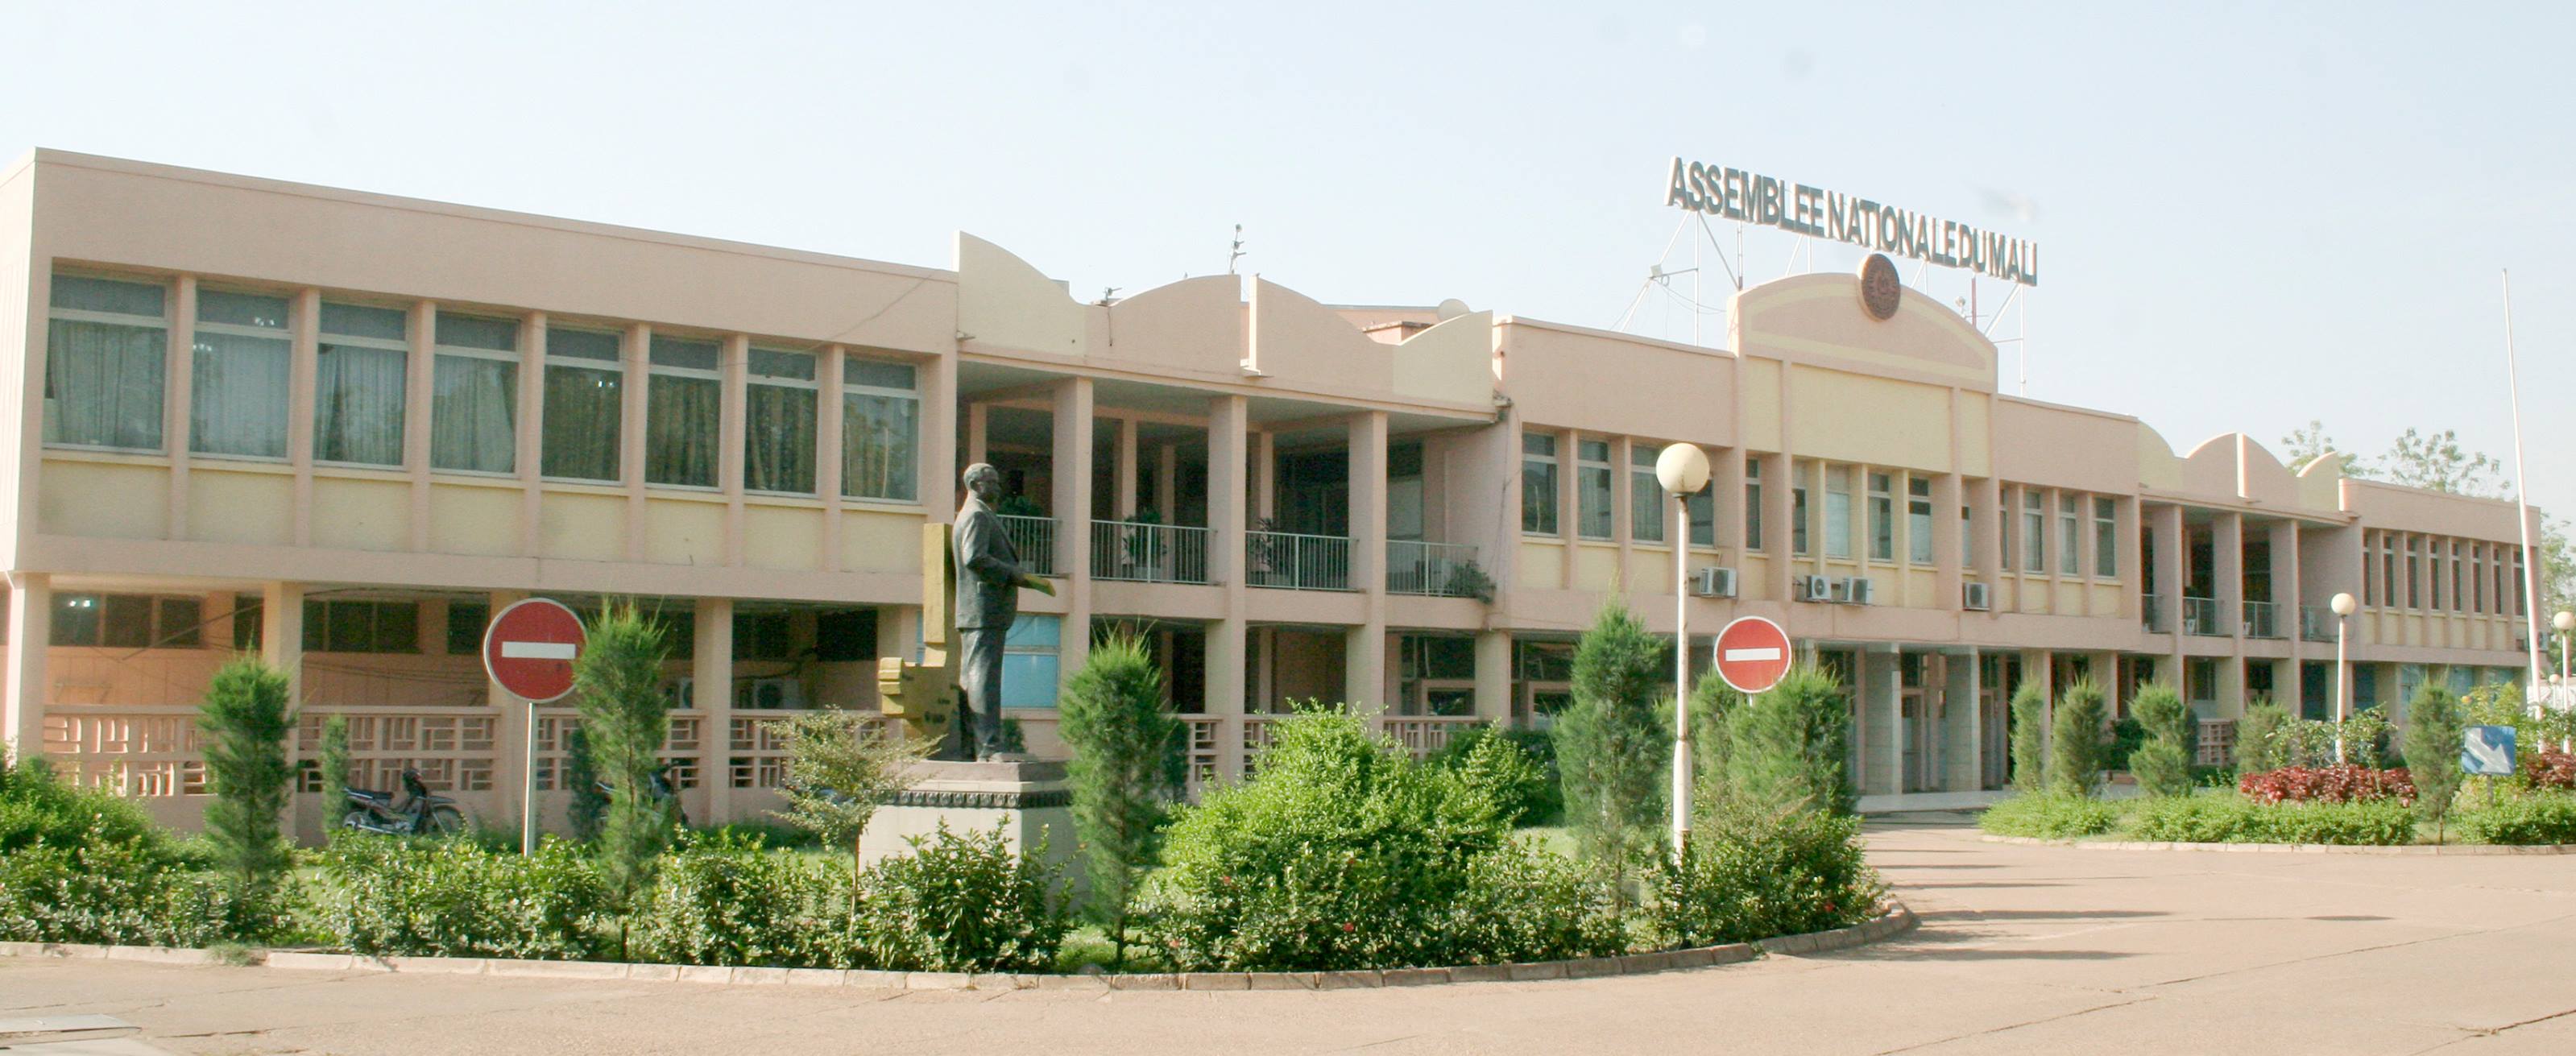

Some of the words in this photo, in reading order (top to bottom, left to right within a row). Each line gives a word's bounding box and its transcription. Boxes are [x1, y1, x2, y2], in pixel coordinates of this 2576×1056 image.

[1664, 155, 1824, 238] ASSEMBLEE
[1824, 189, 1957, 267] NATIONALE
[1957, 221, 1986, 274] DU
[1986, 230, 2037, 287] MALI
